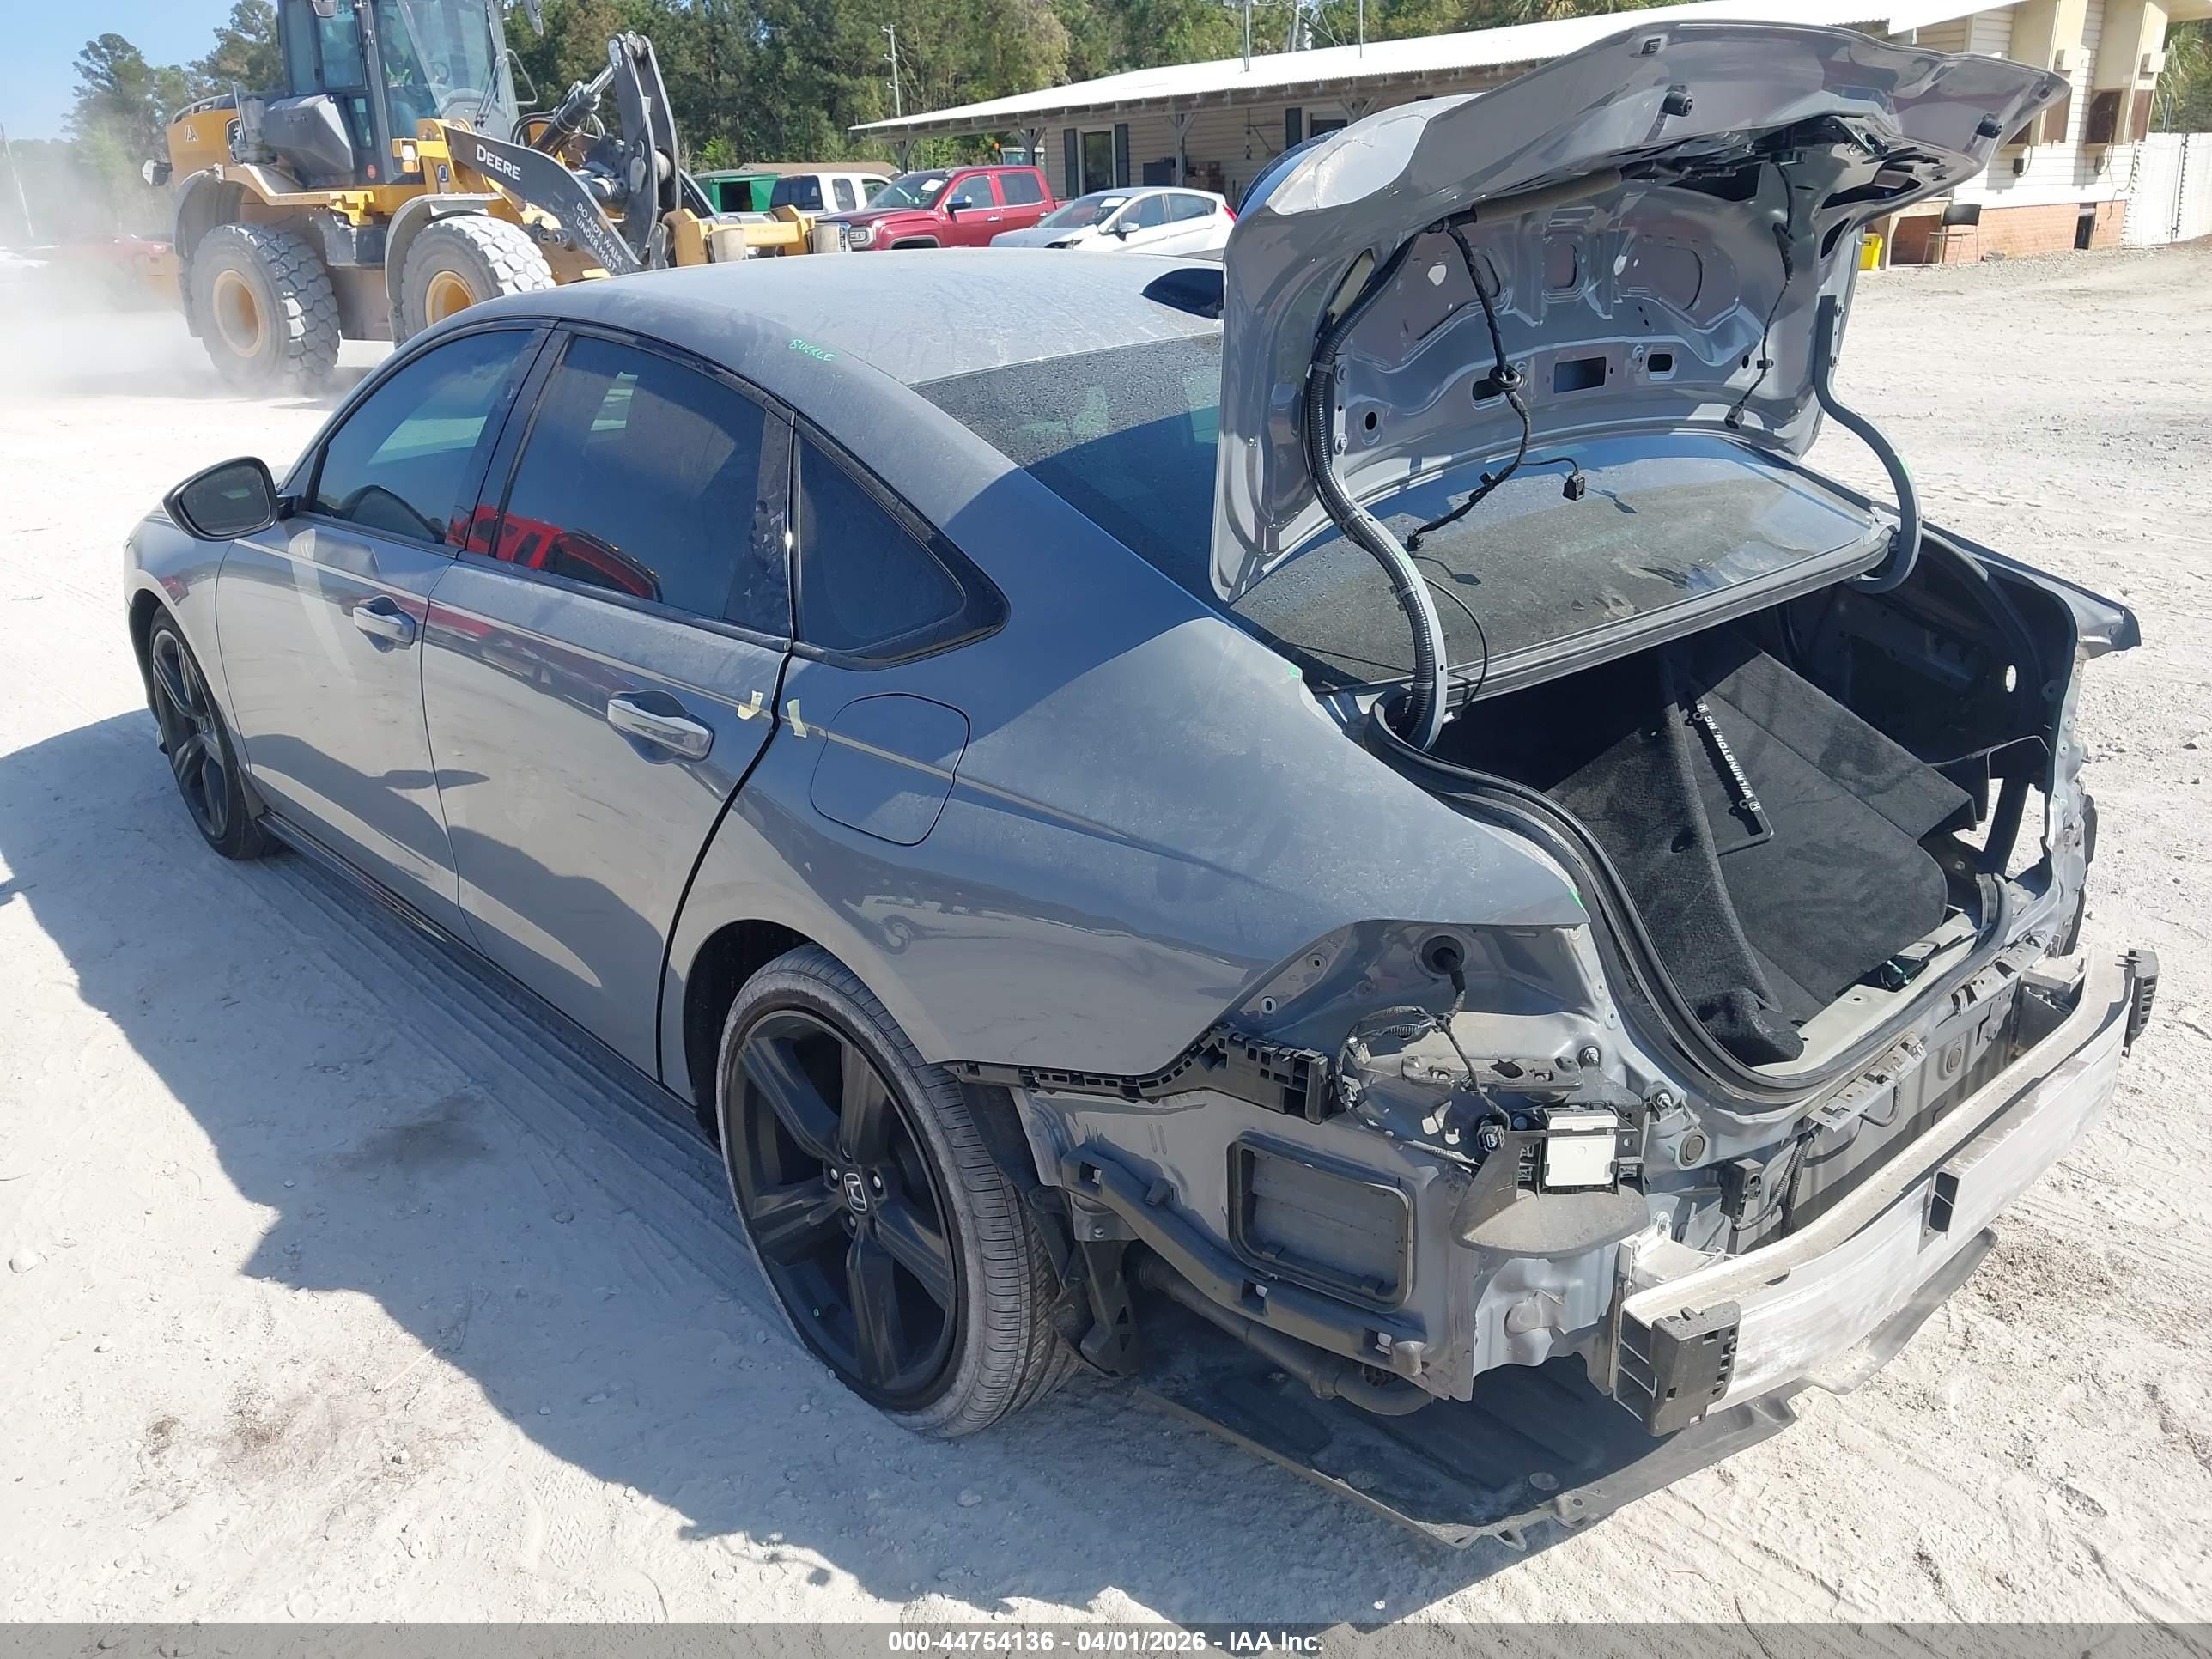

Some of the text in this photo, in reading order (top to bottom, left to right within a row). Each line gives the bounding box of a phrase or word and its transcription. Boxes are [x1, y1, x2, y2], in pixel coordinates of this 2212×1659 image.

[476, 143, 521, 181] DEERE
[576, 201, 623, 266] DO NOT WALK
[576, 216, 617, 271] UNDER MAST
[788, 338, 837, 362] BUCKLE
[1704, 715, 1754, 799] WILMINGTON, NC
